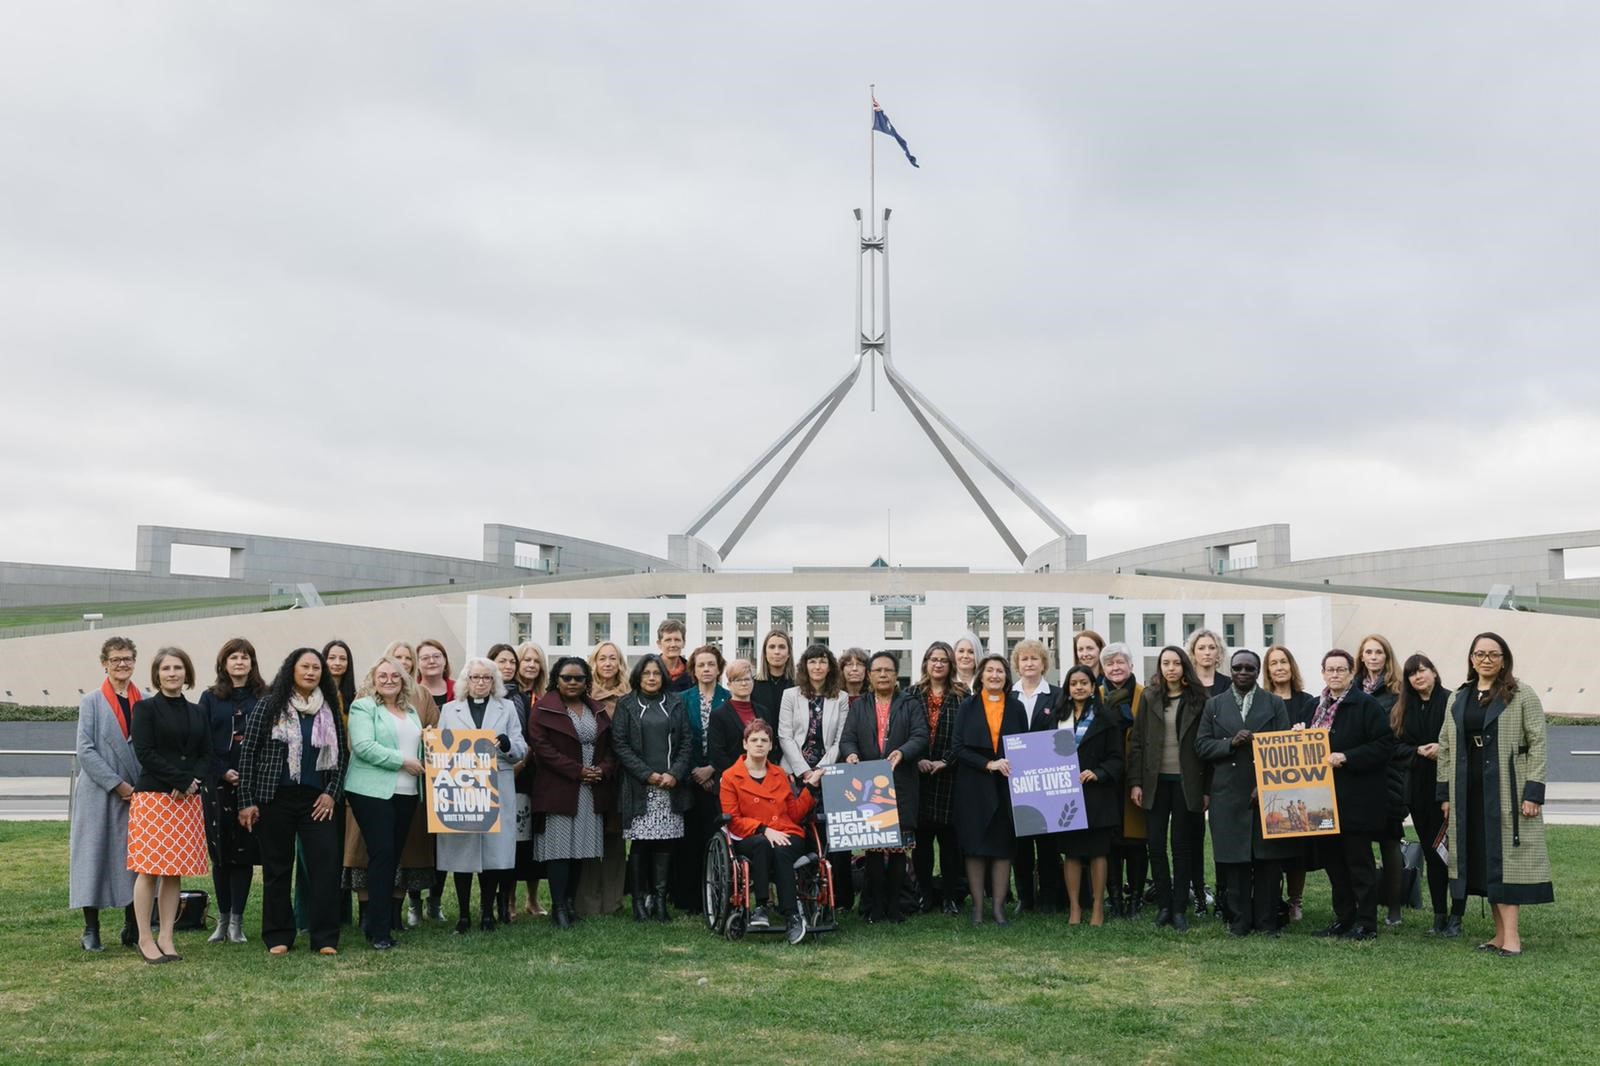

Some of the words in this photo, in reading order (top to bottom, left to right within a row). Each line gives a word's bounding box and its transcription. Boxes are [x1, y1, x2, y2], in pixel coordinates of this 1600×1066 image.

[1256, 733, 1302, 745] WRITE
[1304, 732, 1325, 741] TO
[431, 752, 451, 769] THE
[453, 752, 477, 769] TIME
[478, 752, 491, 769] TO
[1258, 745, 1299, 769] YOUR
[1302, 742, 1326, 766] MP
[433, 769, 492, 787] ACT
[1037, 766, 1055, 775] CAN
[1056, 764, 1077, 772] HELP
[1262, 766, 1327, 785] NOW
[1012, 775, 1041, 794] SAVE
[1041, 771, 1073, 791] LIVES
[433, 788, 450, 812] IS
[453, 788, 492, 812] NOW
[827, 809, 874, 824] HELP
[828, 820, 883, 836] FIGHT
[829, 831, 898, 848] FAMINE
